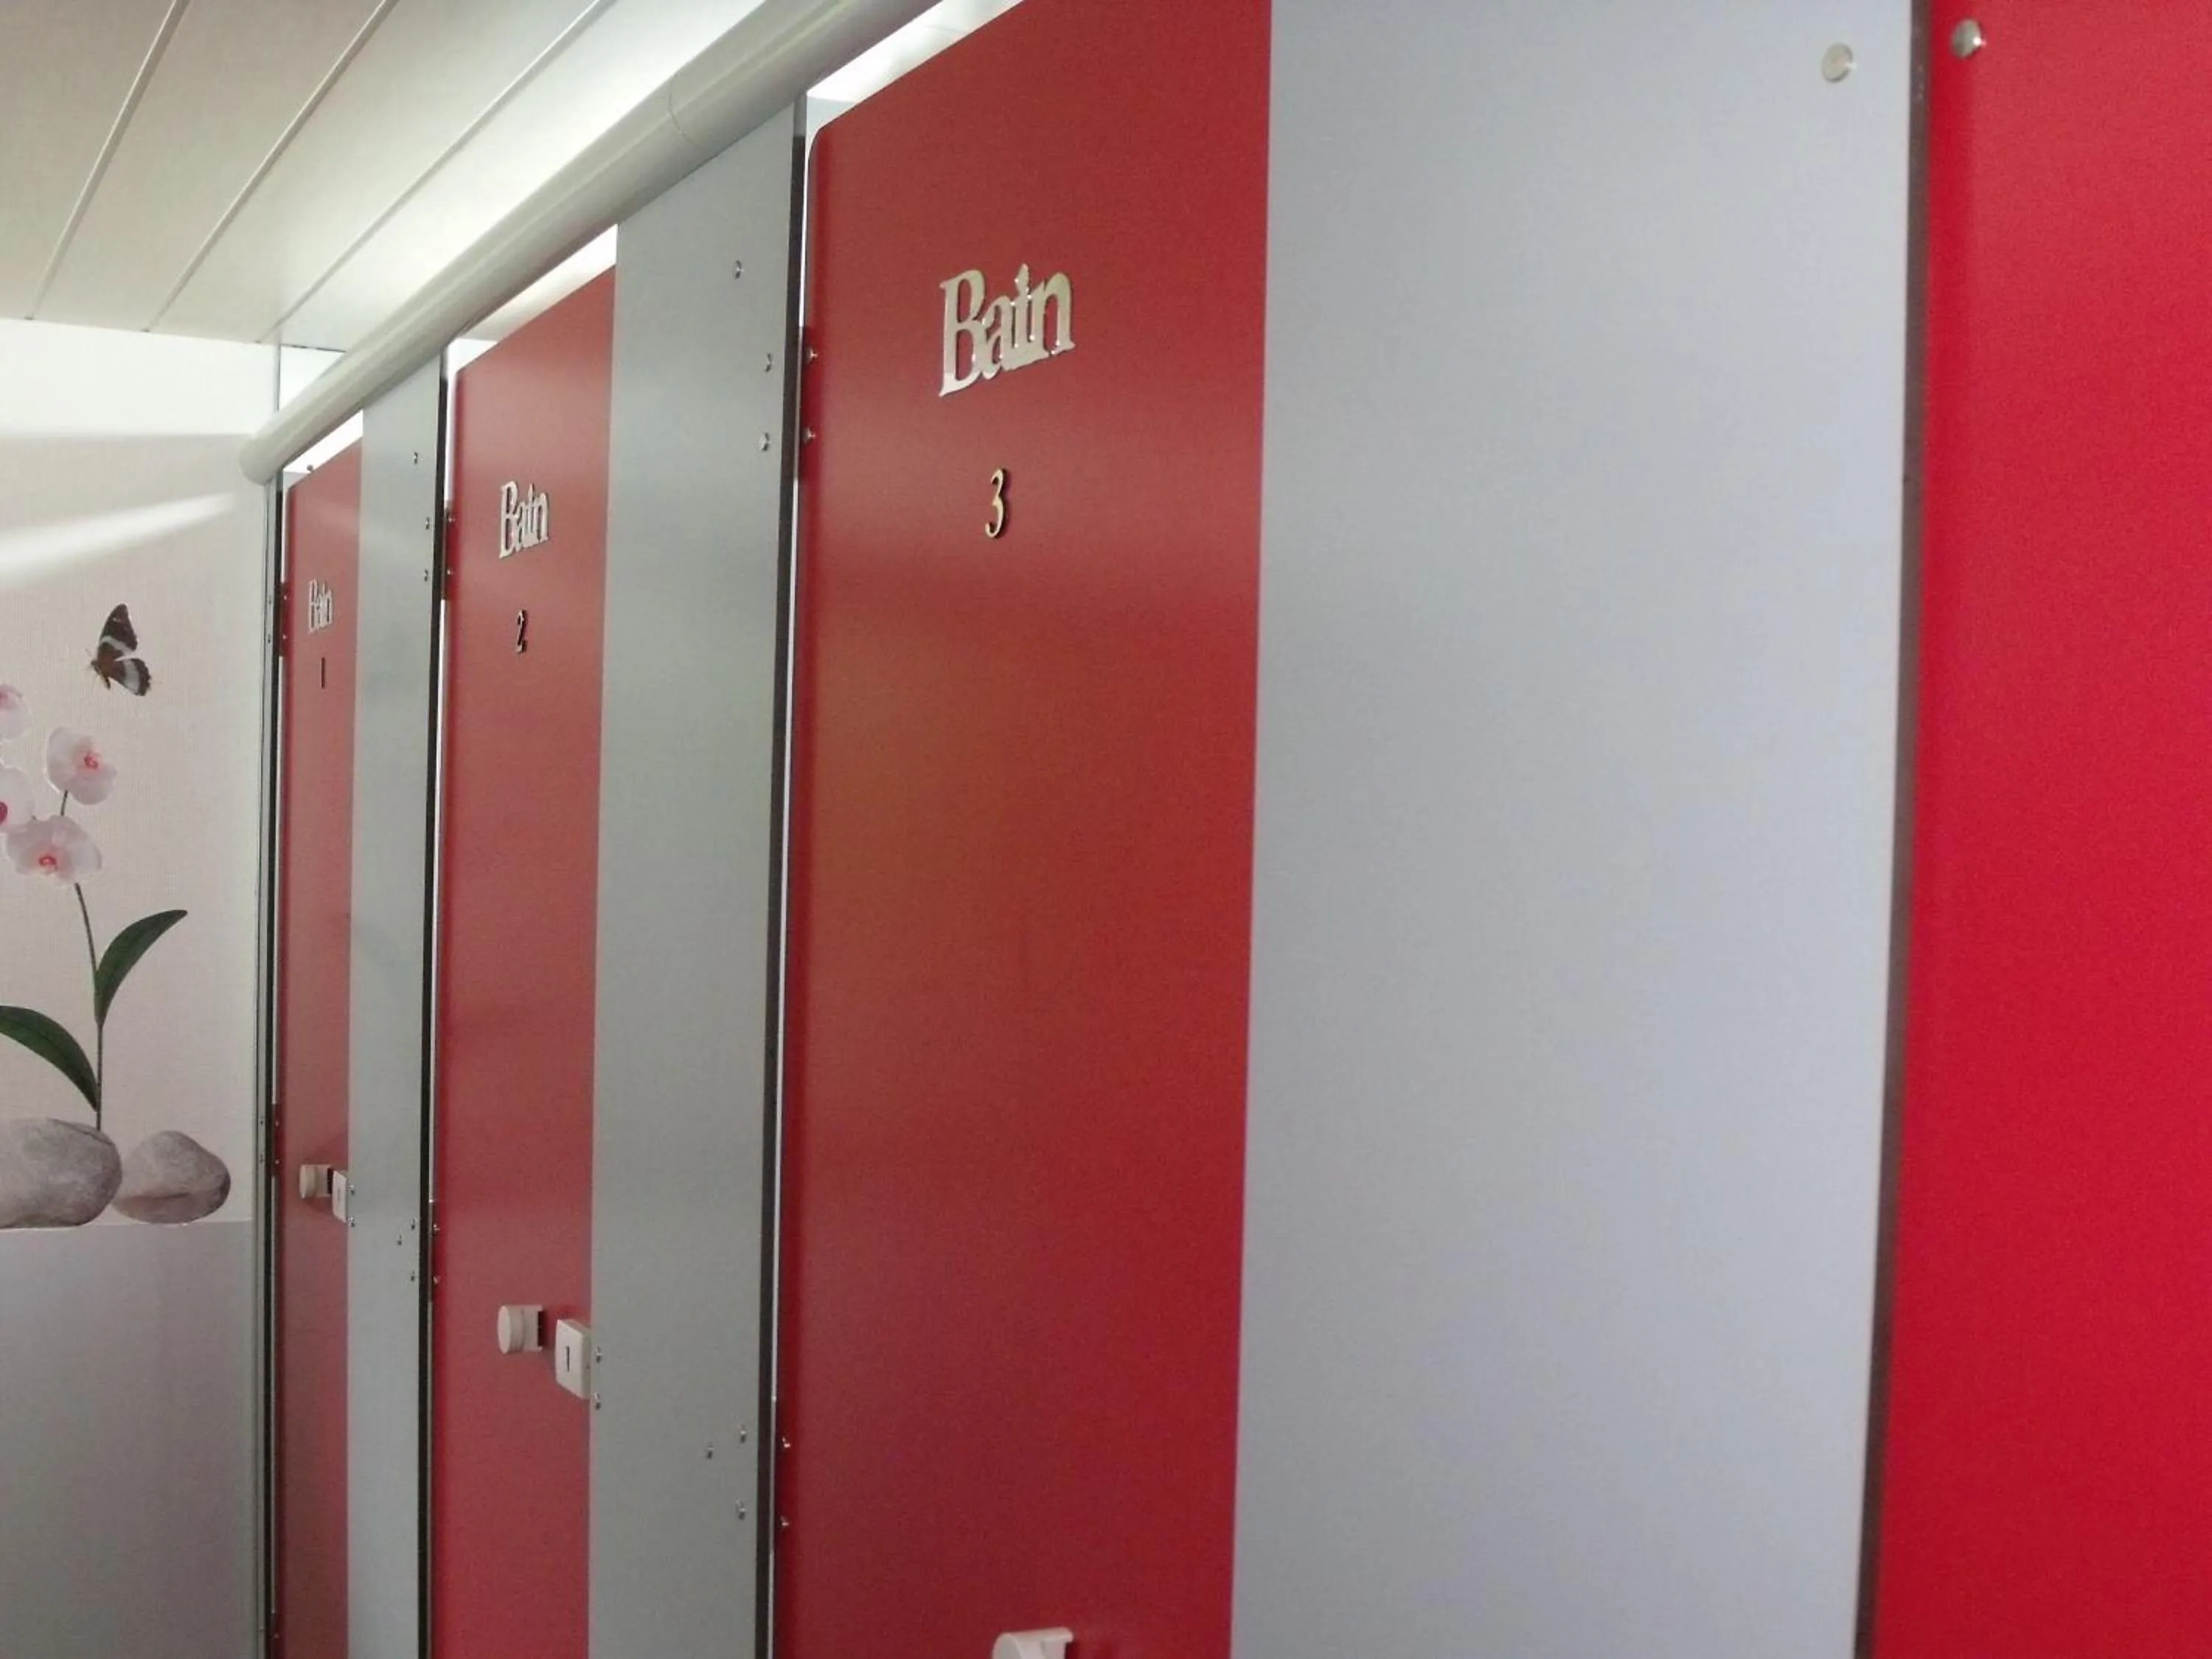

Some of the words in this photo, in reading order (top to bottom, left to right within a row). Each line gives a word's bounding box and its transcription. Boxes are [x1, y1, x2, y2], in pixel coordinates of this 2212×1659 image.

[938, 263, 1076, 397] Bain
[498, 480, 551, 559] Bain
[985, 468, 1007, 538] 3
[308, 578, 333, 633] Bain
[516, 609, 529, 653] 2
[320, 656, 326, 689] 1
